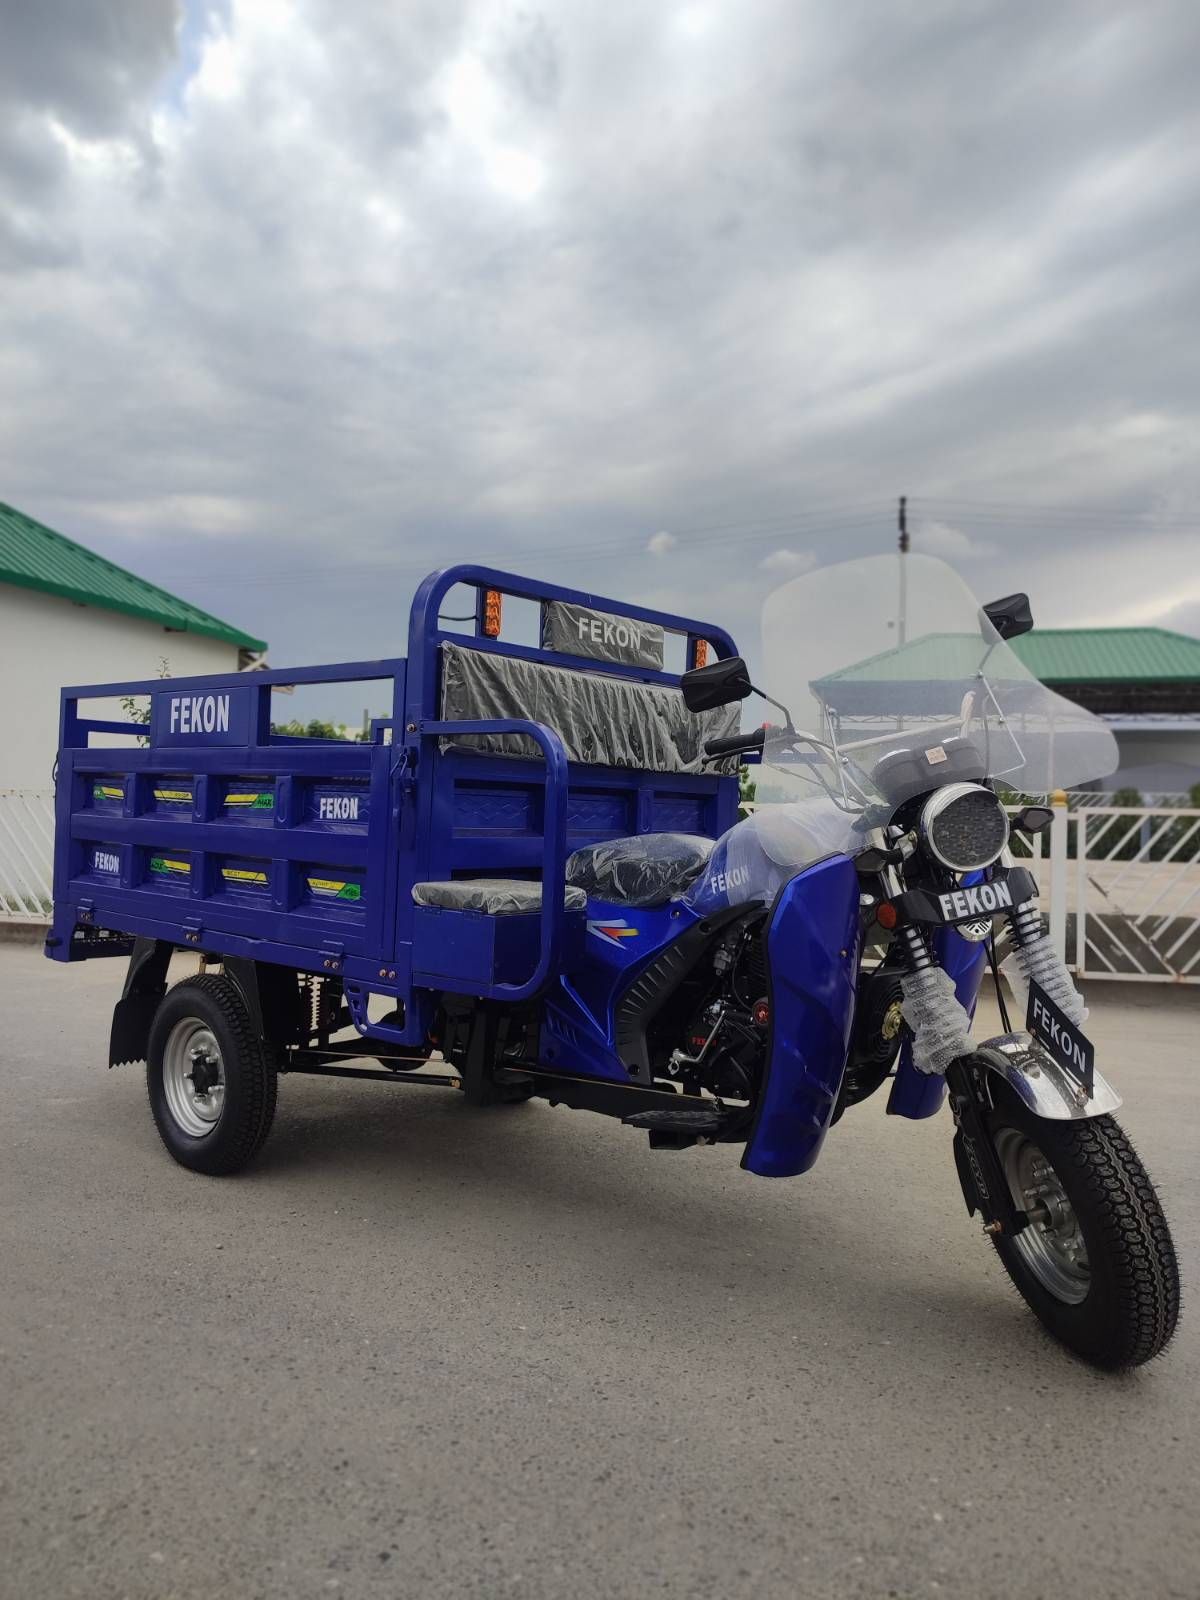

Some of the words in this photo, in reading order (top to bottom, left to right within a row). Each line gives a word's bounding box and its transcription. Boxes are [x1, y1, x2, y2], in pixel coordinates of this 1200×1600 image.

[578, 617, 641, 650] FEKON
[170, 695, 230, 734] FEKON
[319, 797, 359, 820] FEKON
[94, 851, 120, 873] FEKON
[711, 864, 750, 894] FEKON
[938, 882, 1013, 921] FEKON
[1033, 997, 1086, 1073] FEKON
